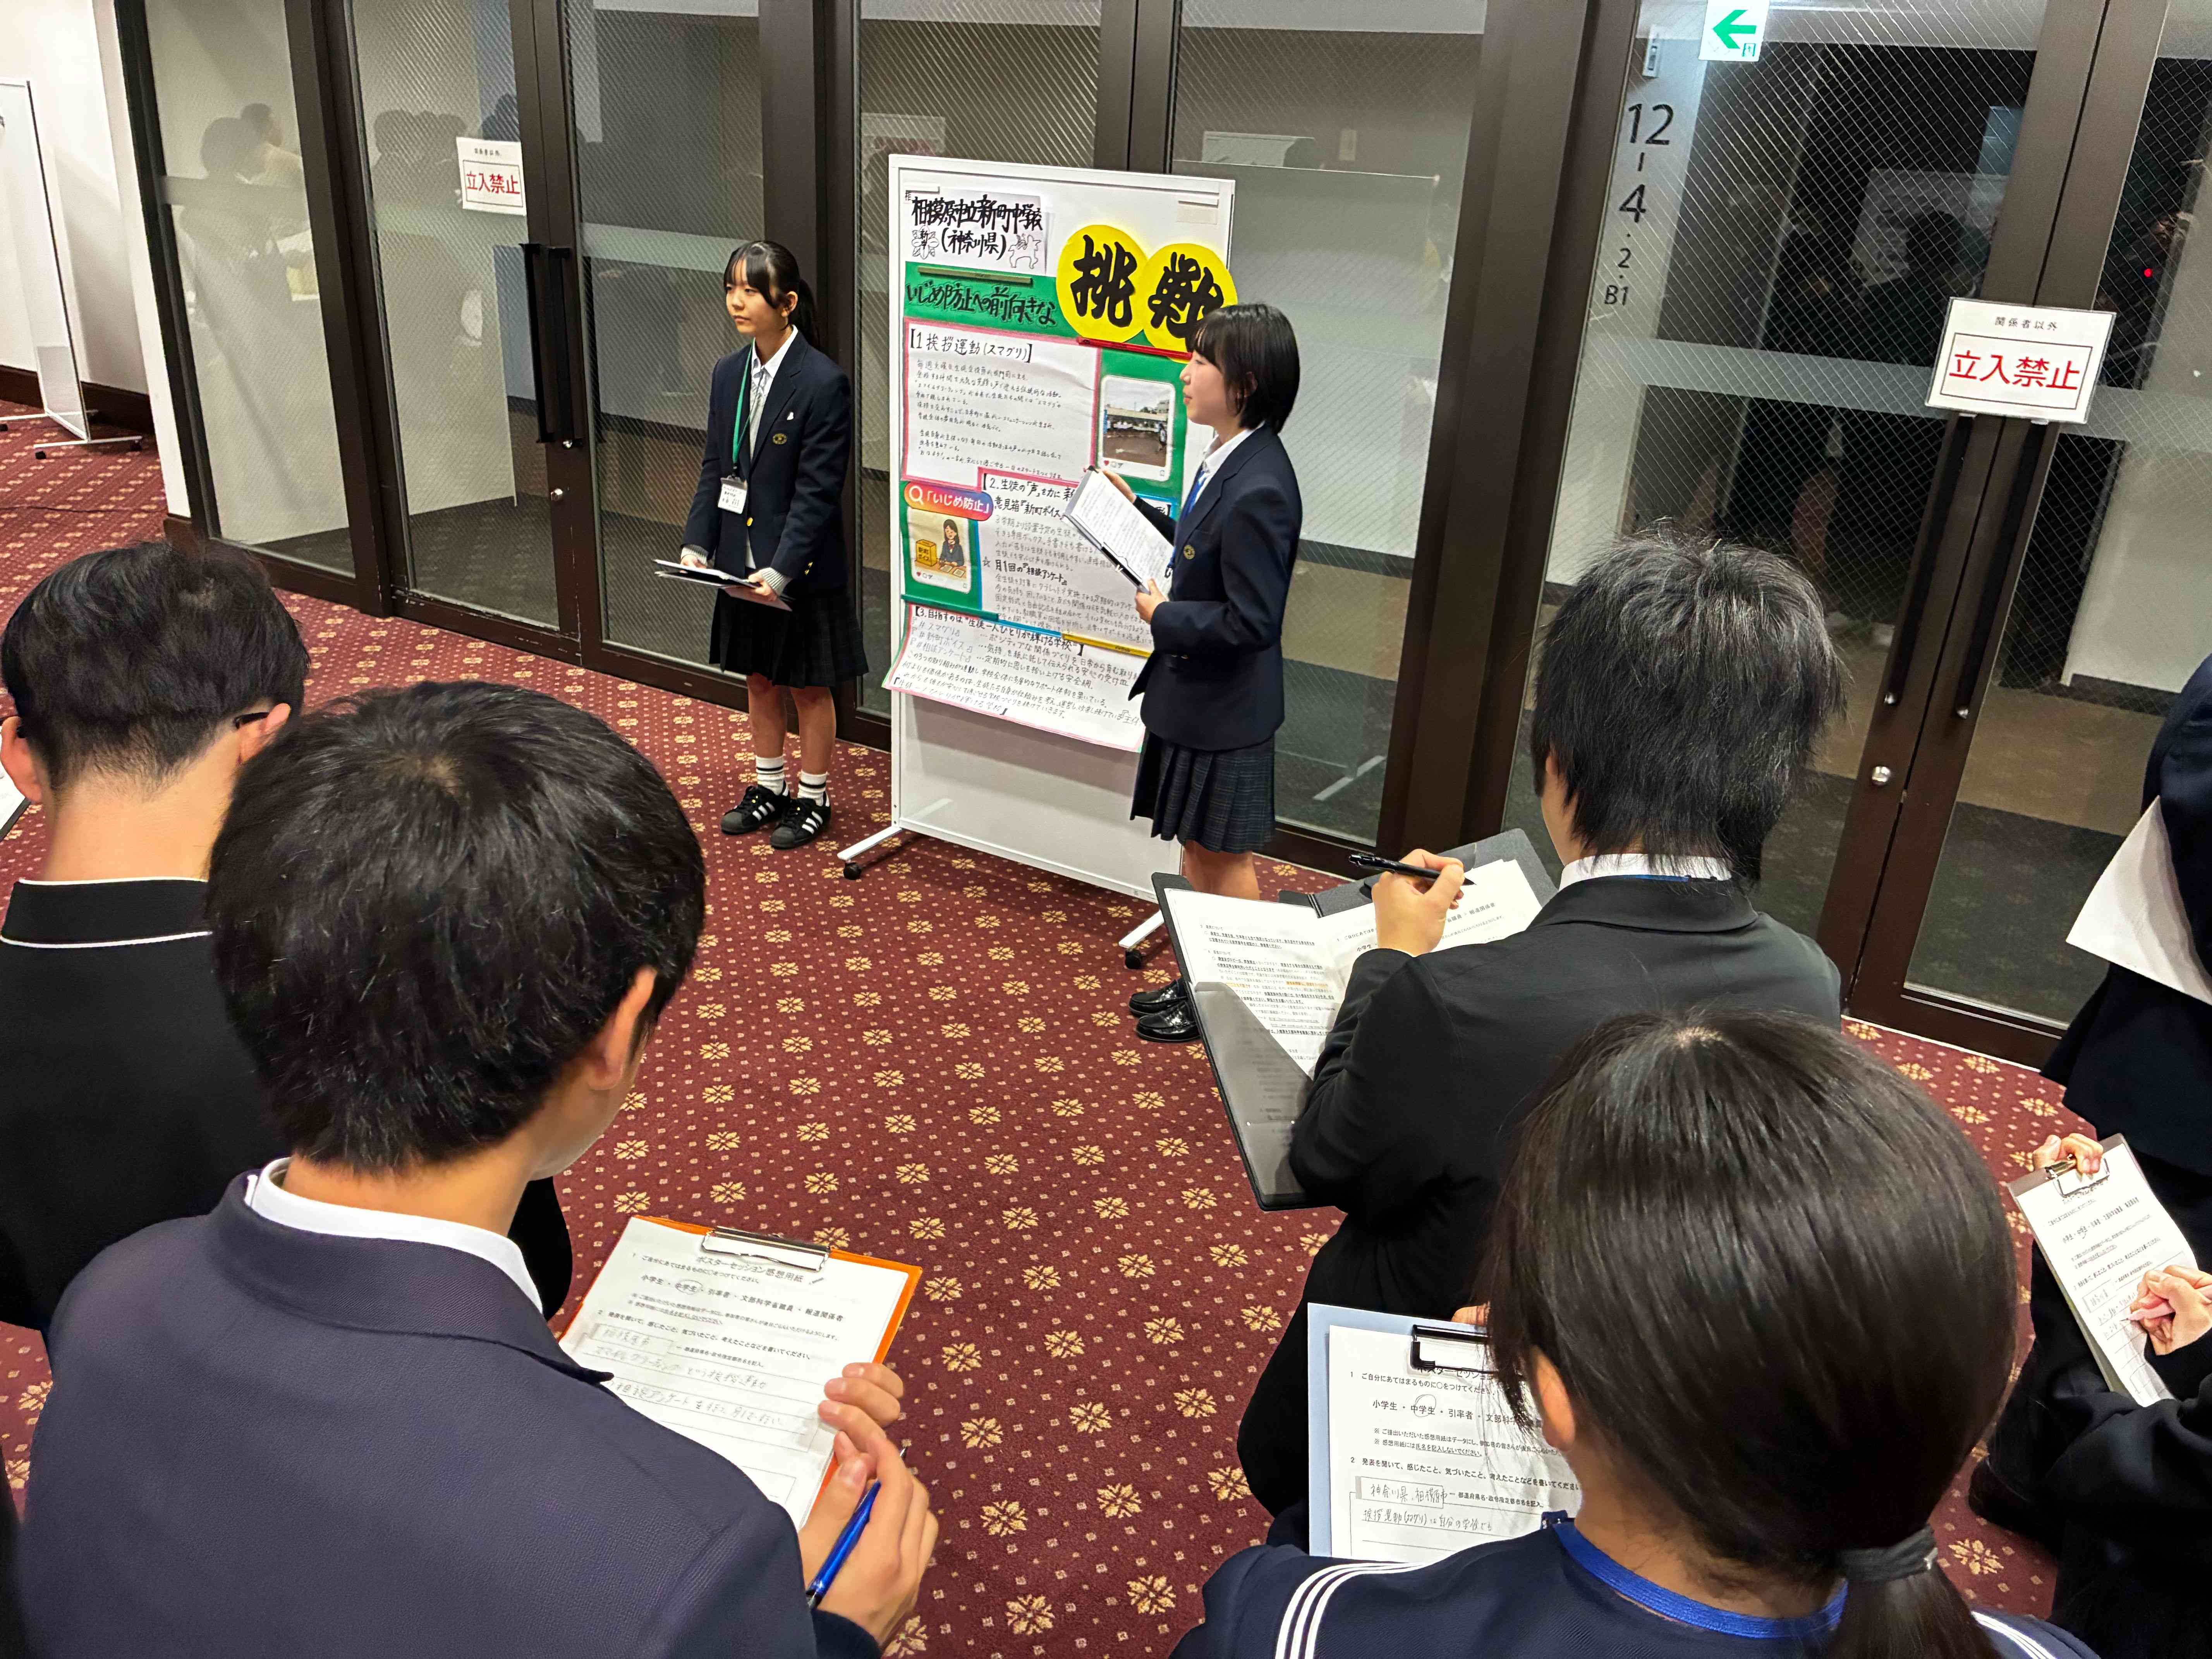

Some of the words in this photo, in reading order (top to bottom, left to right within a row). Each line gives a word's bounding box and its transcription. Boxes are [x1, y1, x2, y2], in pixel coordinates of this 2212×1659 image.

[1628, 103, 1674, 146] 12
[465, 171, 520, 194] 立入禁止
[1619, 184, 1646, 223] 4
[941, 227, 1006, 260] (神奈川県)
[1618, 248, 1632, 268] 2
[906, 280, 1056, 325] いじめ防止への前向きな
[1604, 285, 1629, 306] B1
[1994, 316, 2058, 331] 関係者以外
[1949, 350, 2080, 390] 立入禁止
[927, 488, 991, 514] 「いじめ防止」
[1373, 1399, 1398, 1410] 小学生
[1411, 1404, 1435, 1415] 中学生
[1448, 1409, 1474, 1420] 引率者
